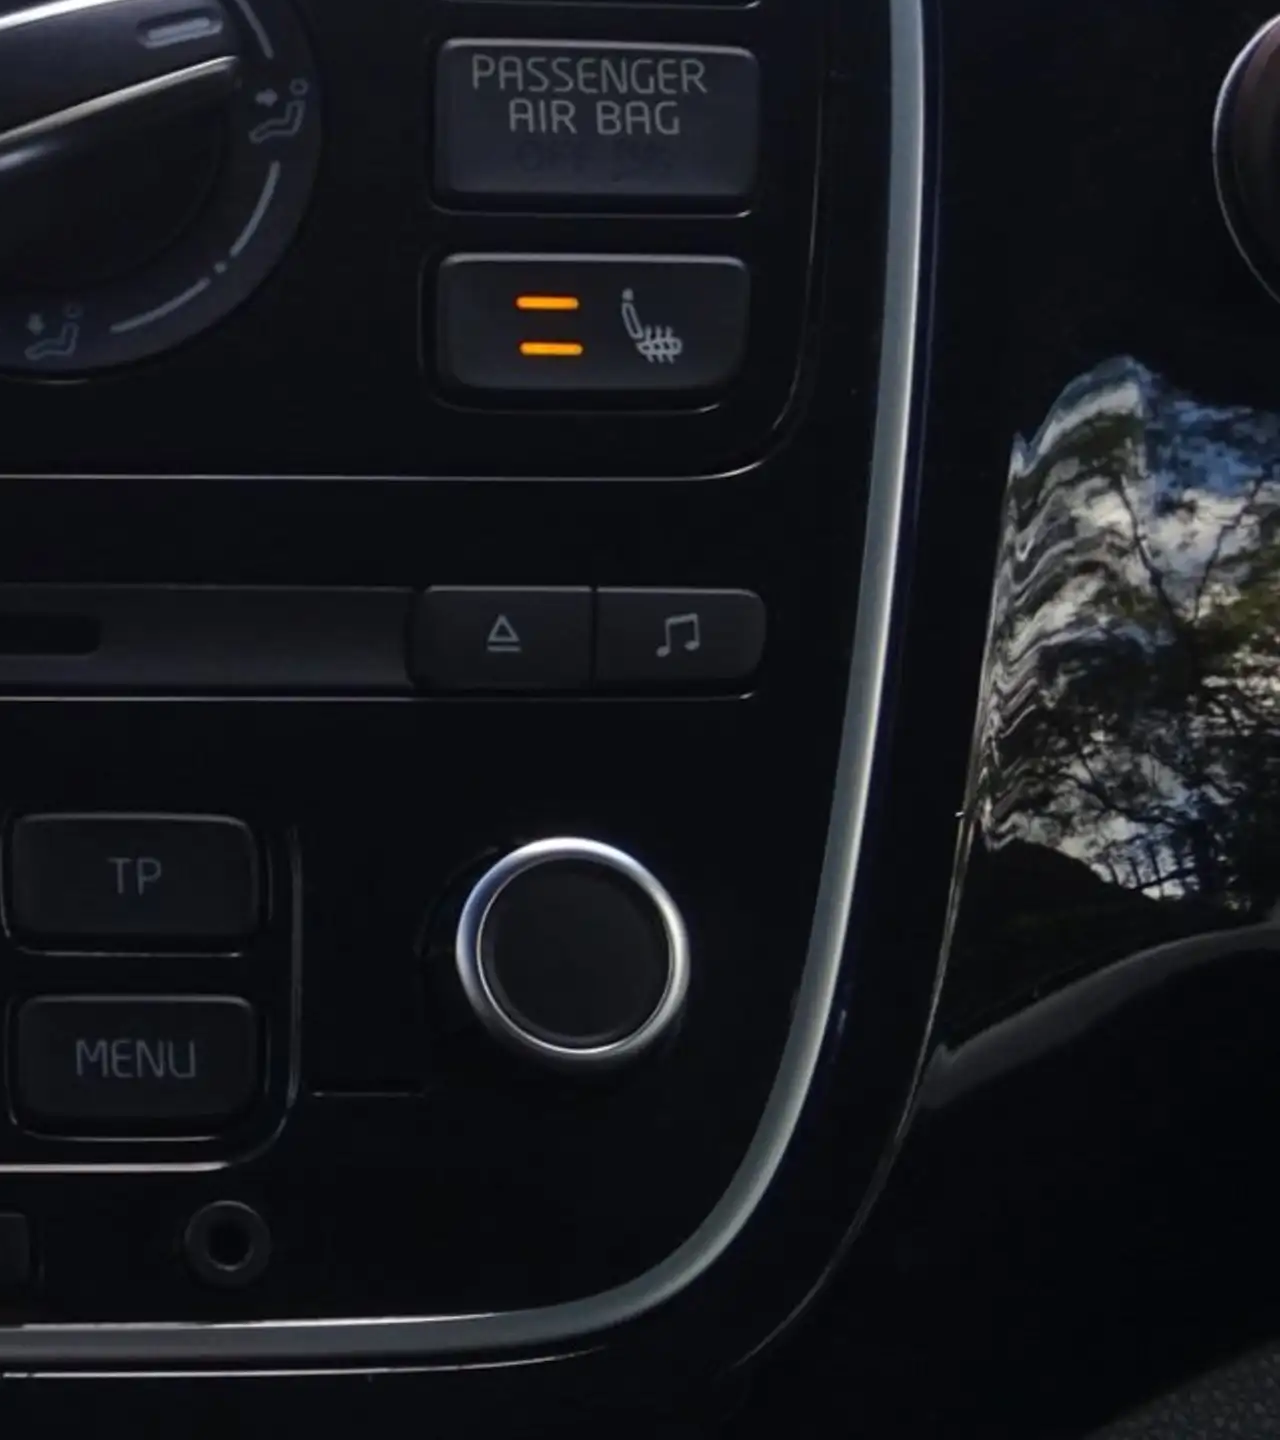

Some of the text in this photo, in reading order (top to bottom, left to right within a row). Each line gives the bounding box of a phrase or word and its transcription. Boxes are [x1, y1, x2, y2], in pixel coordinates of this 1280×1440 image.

[472, 54, 708, 95] PASSENGER
[508, 98, 681, 136] AIR BAG
[109, 857, 163, 895] TP
[75, 1037, 198, 1081] MENU
